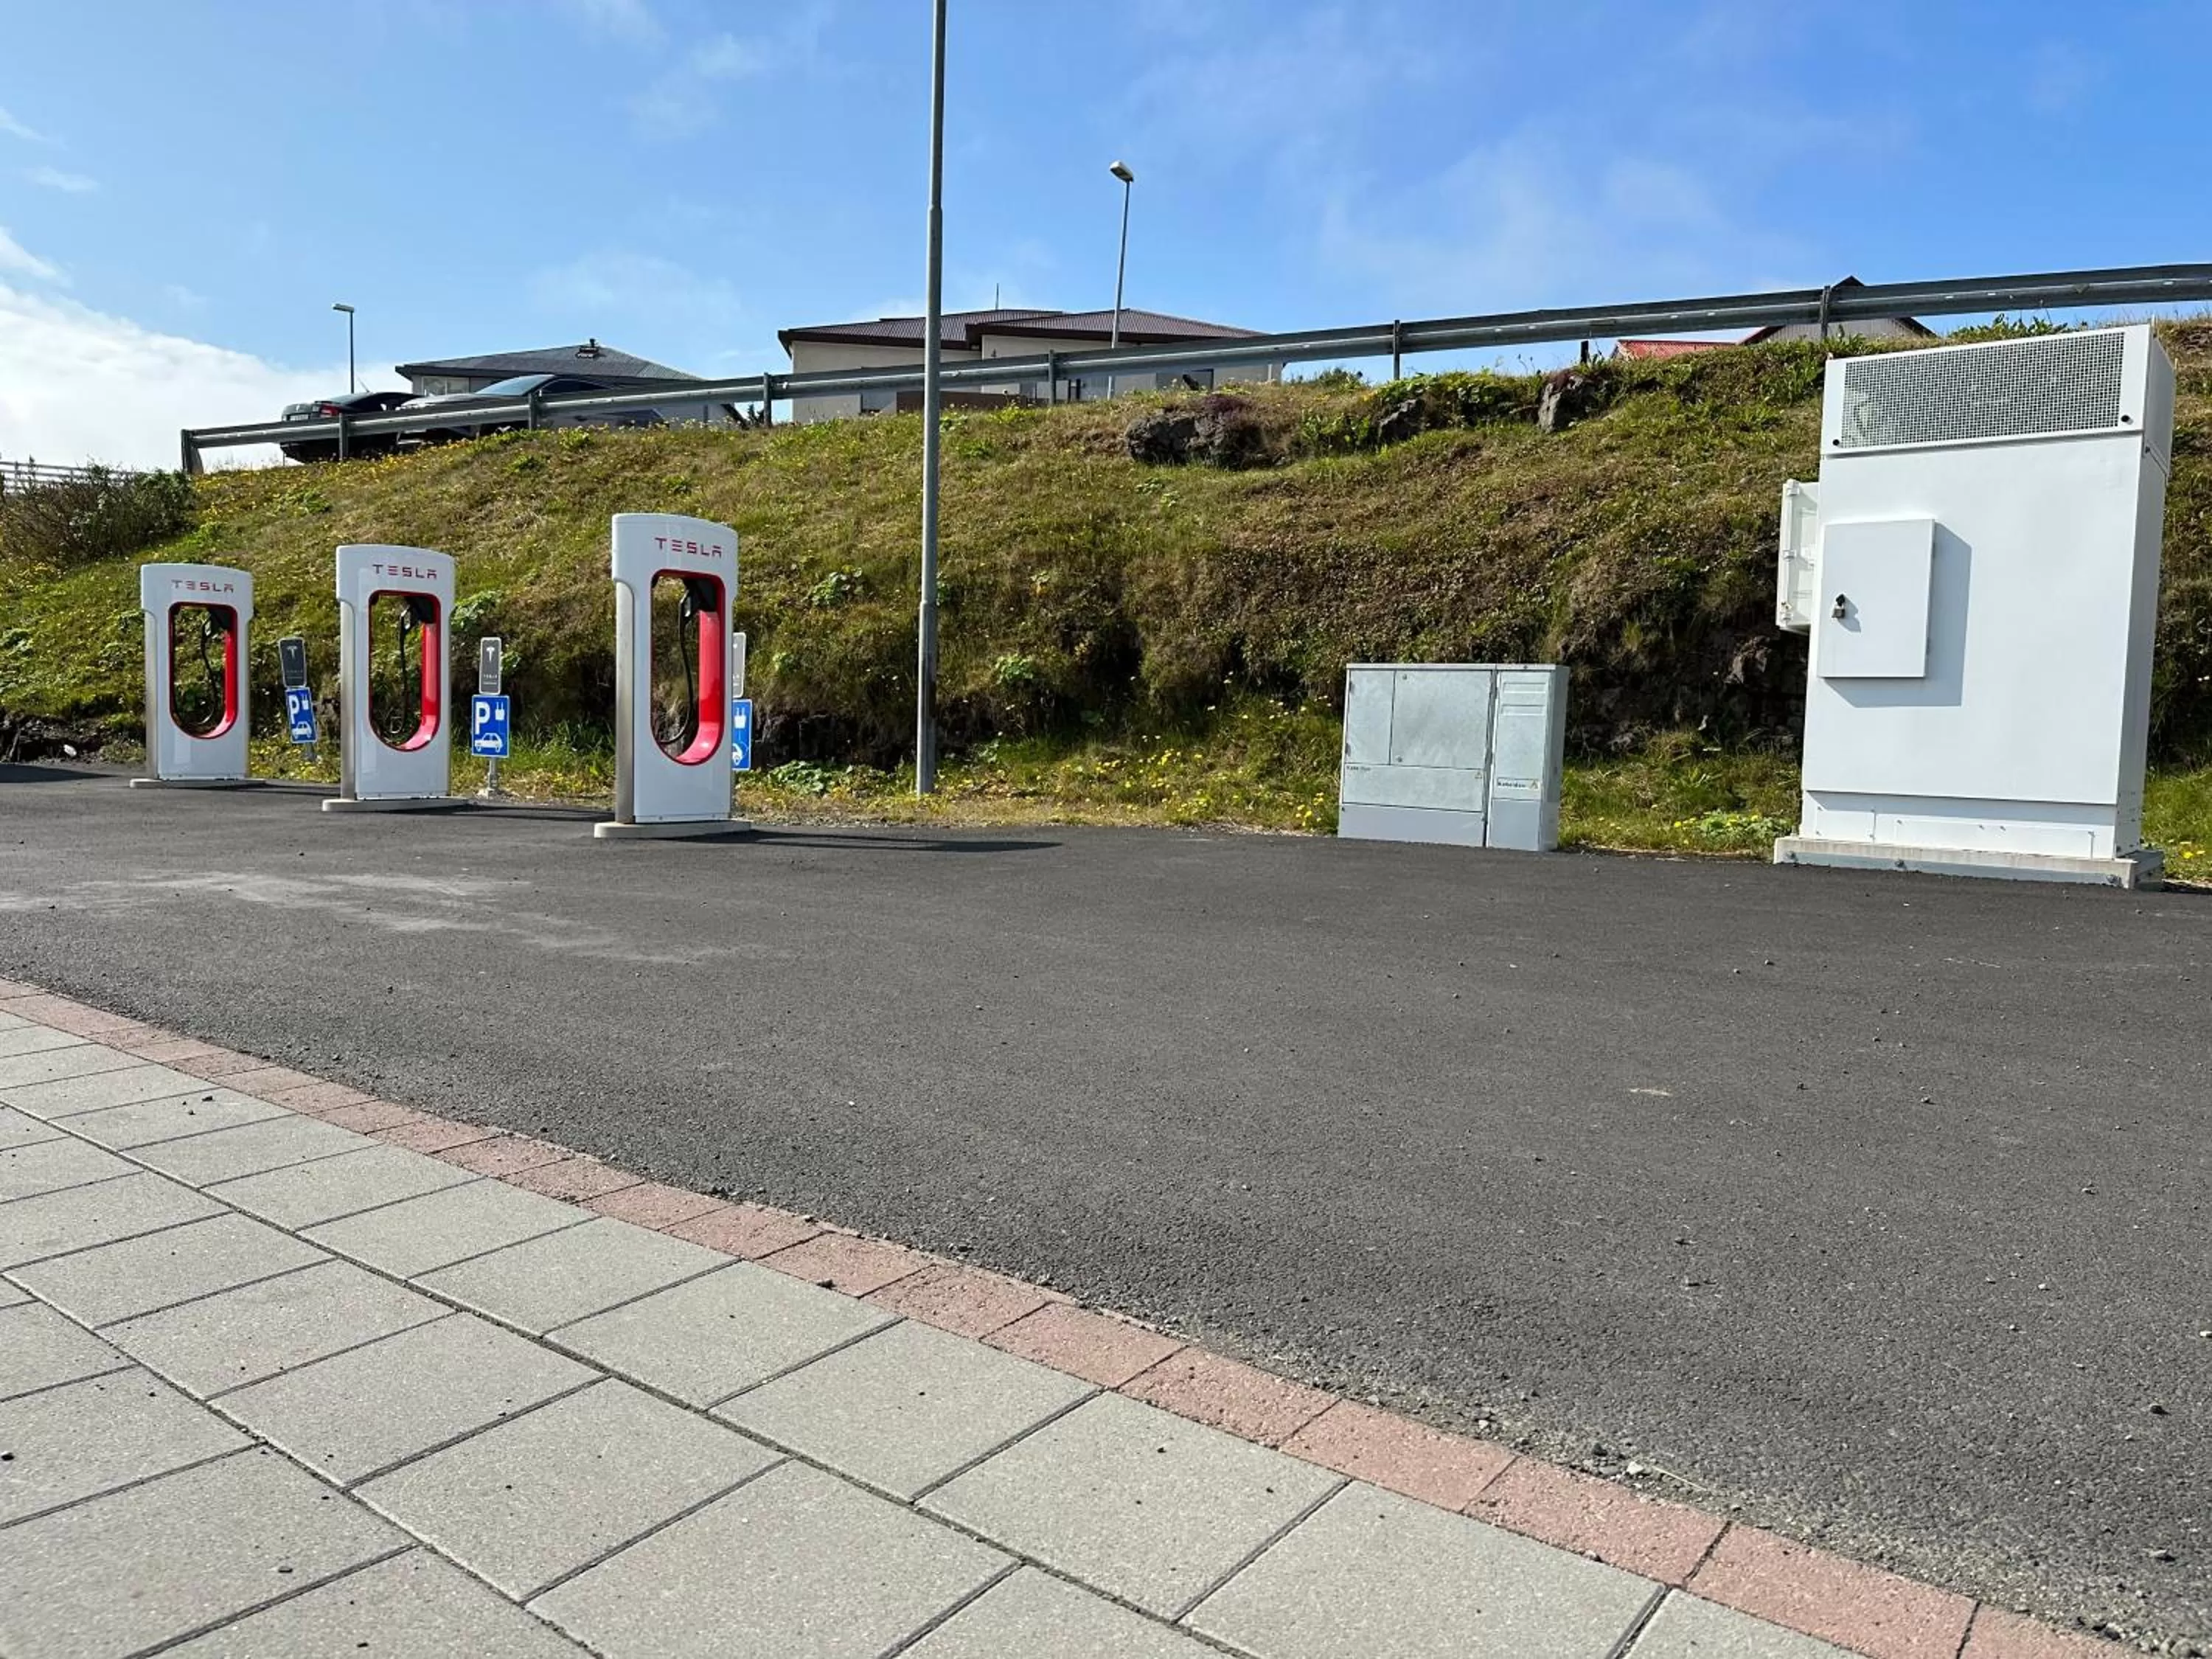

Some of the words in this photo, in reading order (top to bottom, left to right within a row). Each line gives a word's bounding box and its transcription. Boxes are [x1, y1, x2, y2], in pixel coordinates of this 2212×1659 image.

[655, 538, 722, 558] TESLA
[372, 564, 437, 580] TESLA
[171, 579, 234, 593] TESLA
[288, 695, 300, 724] P
[475, 701, 490, 735] P
